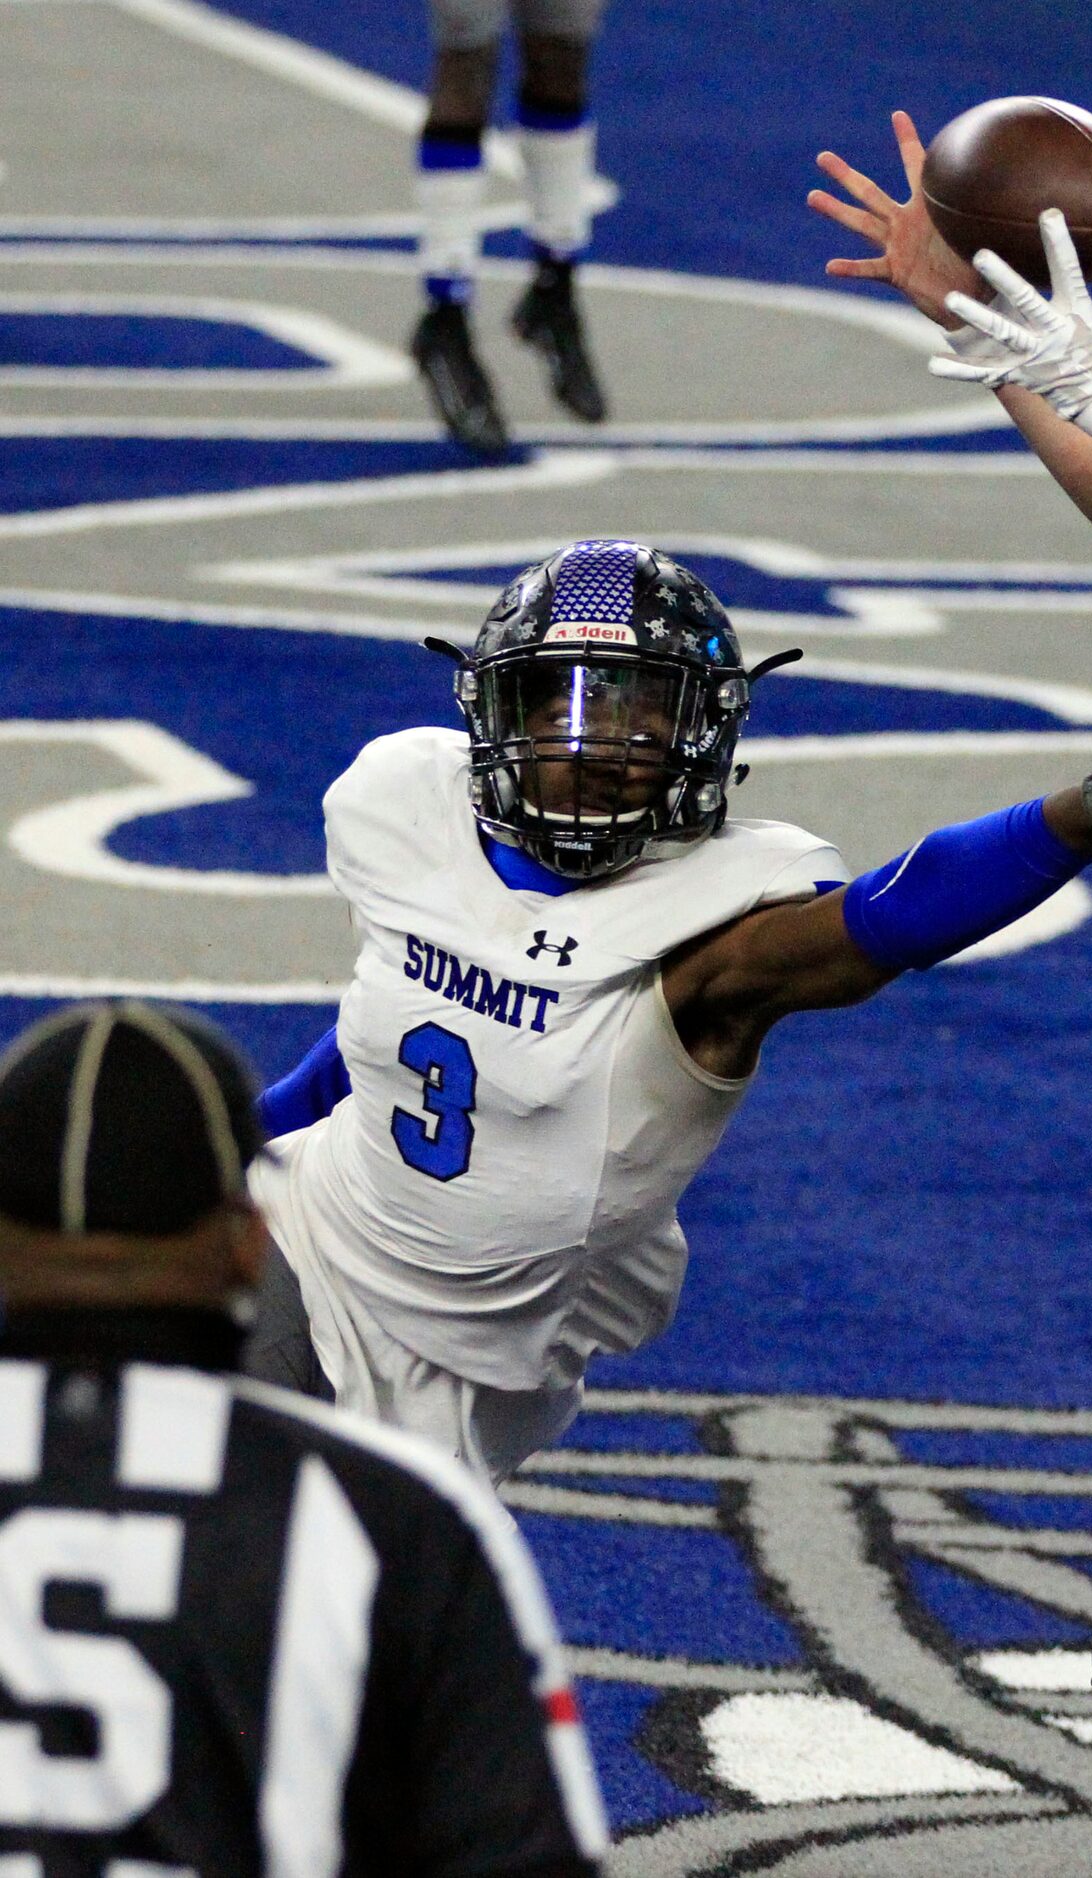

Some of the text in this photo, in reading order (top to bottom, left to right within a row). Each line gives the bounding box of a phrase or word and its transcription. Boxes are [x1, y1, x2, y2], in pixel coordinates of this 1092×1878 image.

[404, 933, 560, 1033] SUMMIT
[390, 1020, 477, 1183] 3
[0, 1505, 186, 1833] S
